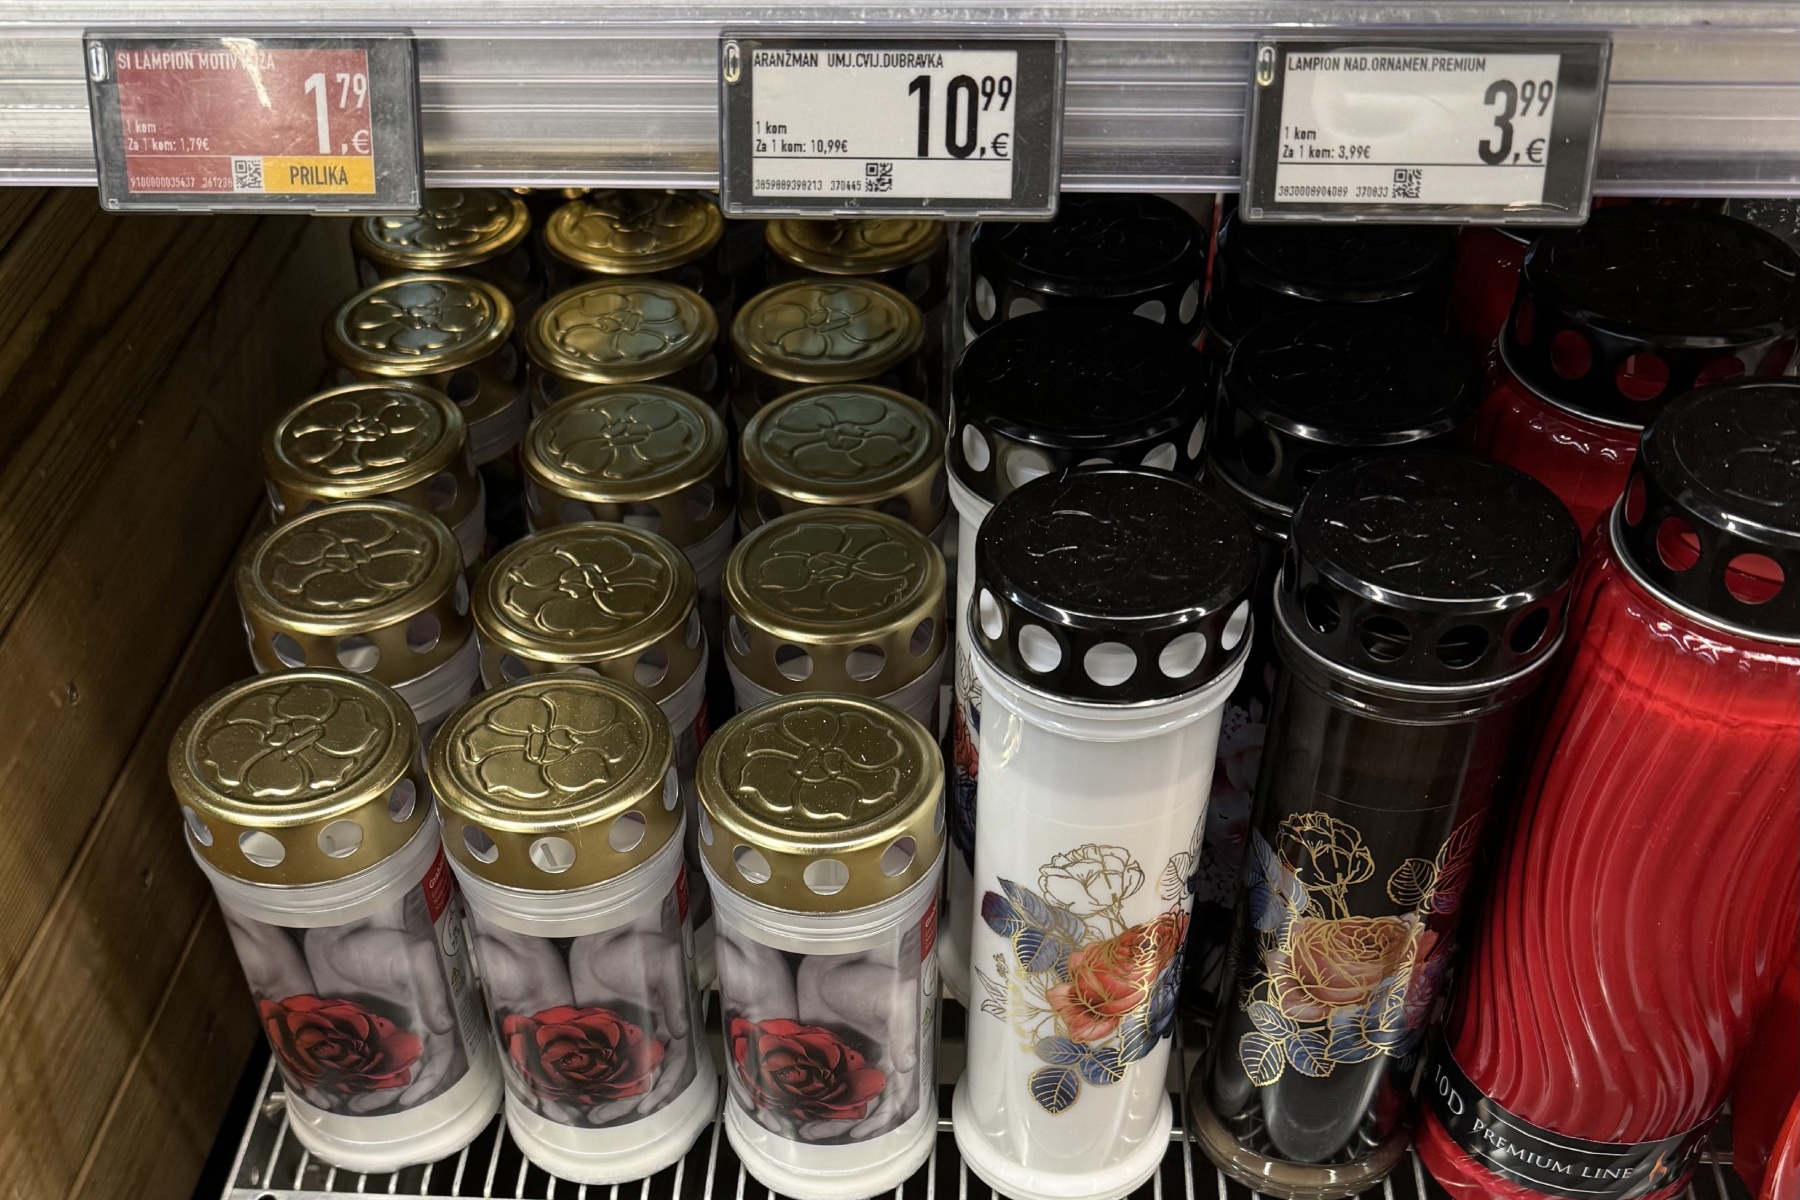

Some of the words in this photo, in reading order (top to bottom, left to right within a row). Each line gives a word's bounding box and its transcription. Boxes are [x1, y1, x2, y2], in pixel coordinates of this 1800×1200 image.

[117, 52, 131, 70] SI
[134, 52, 193, 70] LAMPION
[199, 52, 237, 70] MOTIV
[753, 50, 819, 68] ARANŽMAN
[827, 53, 944, 69] UMJ.CVIJ.DUBRAVKA
[1288, 56, 1341, 72] LAMPION
[1343, 57, 1486, 72] NAD.ORNAMEN.PREMIUM
[335, 73, 368, 109] 79
[981, 75, 1012, 111] 99
[1519, 79, 1554, 117] 99
[126, 120, 132, 133] 1
[135, 120, 157, 134] kom
[755, 121, 761, 135] 1
[765, 121, 787, 135] kom
[1284, 126, 1290, 140] 1
[1294, 126, 1317, 140] kom
[127, 138, 140, 151] Za
[142, 138, 148, 151] 1
[151, 138, 177, 151] kom:
[179, 138, 210, 153] 1,79€
[755, 139, 767, 153] Za
[771, 139, 777, 153] 1
[780, 139, 807, 153] kom:
[810, 139, 848, 154] 10,99€
[1282, 145, 1296, 159] Za
[1299, 145, 1305, 159] 1
[1308, 146, 1335, 159] kom:
[1338, 145, 1371, 160] 3,99€
[289, 165, 349, 186] PRILIKA
[1472, 1117, 1573, 1176] PREMIUM
[1581, 1165, 1635, 1180] LINE
